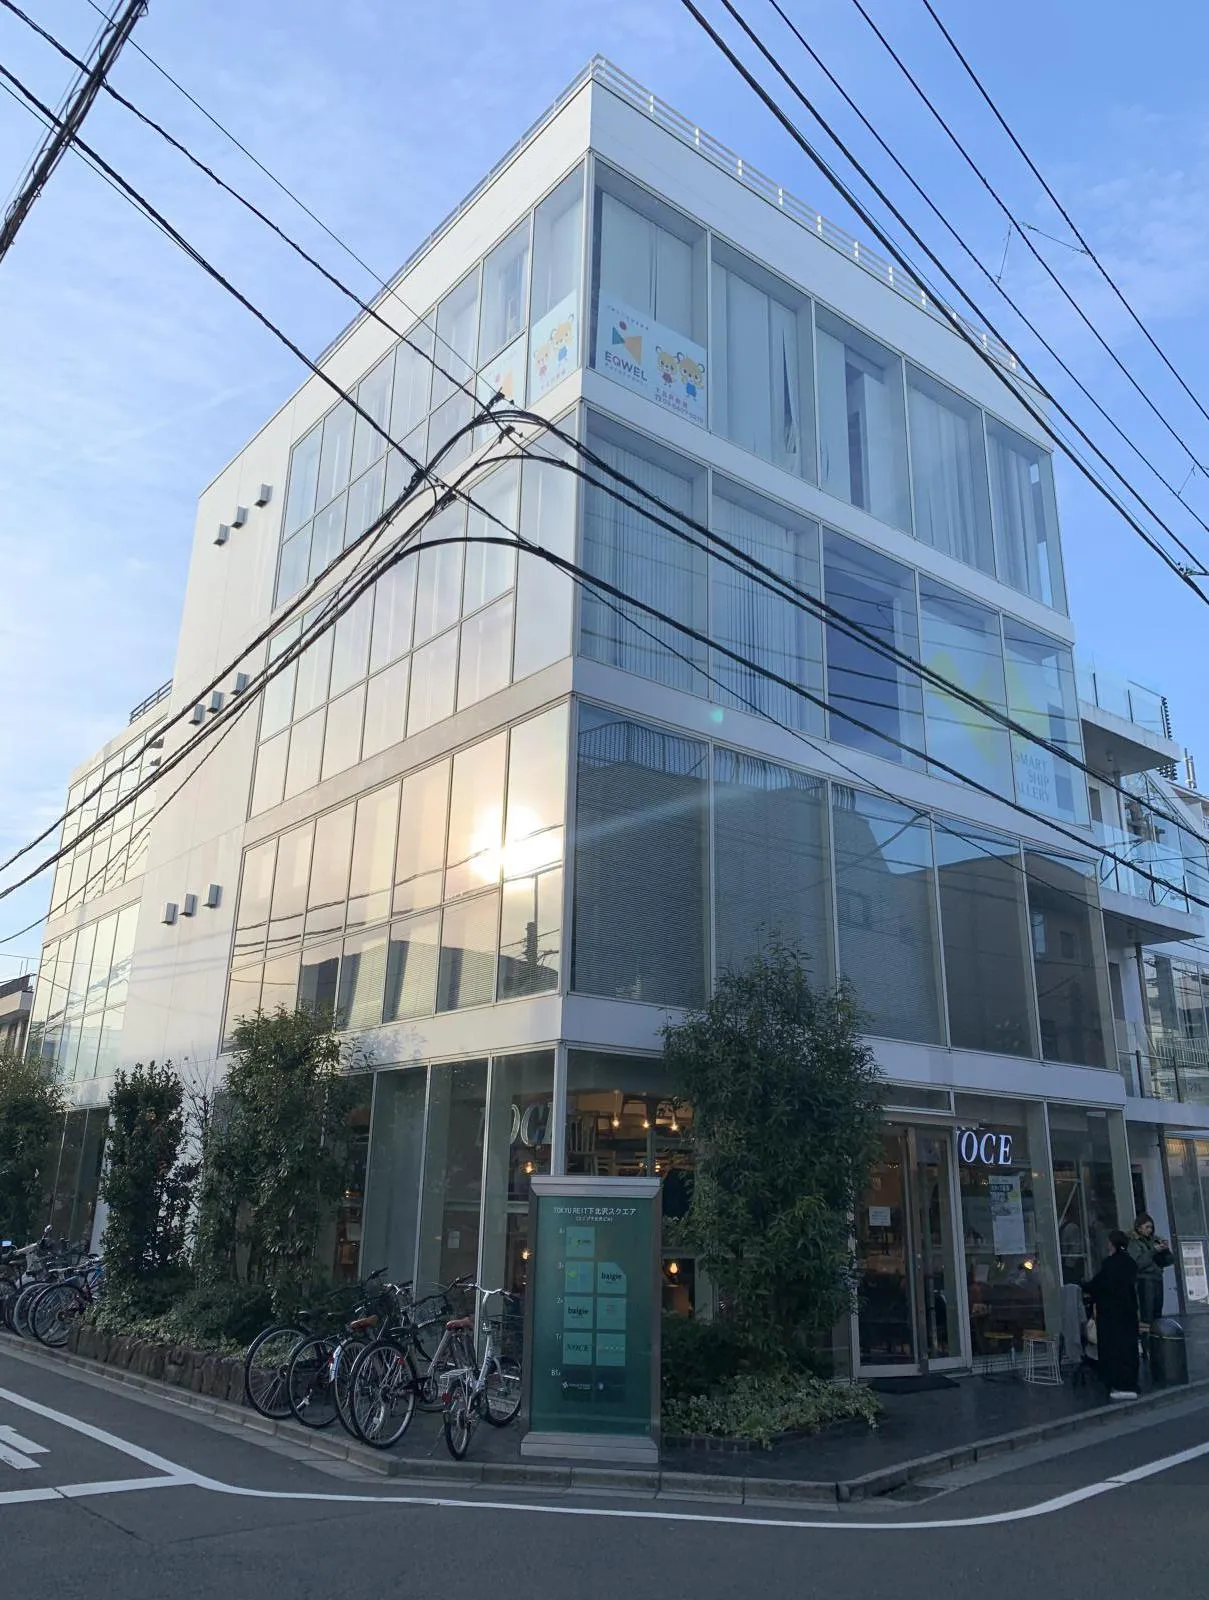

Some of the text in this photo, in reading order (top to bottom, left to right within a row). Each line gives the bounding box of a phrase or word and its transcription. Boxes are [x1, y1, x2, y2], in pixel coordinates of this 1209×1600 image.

[604, 350, 648, 382] EQWEL
[1014, 750, 1048, 774] SMART
[956, 1130, 1013, 1165] OCE
